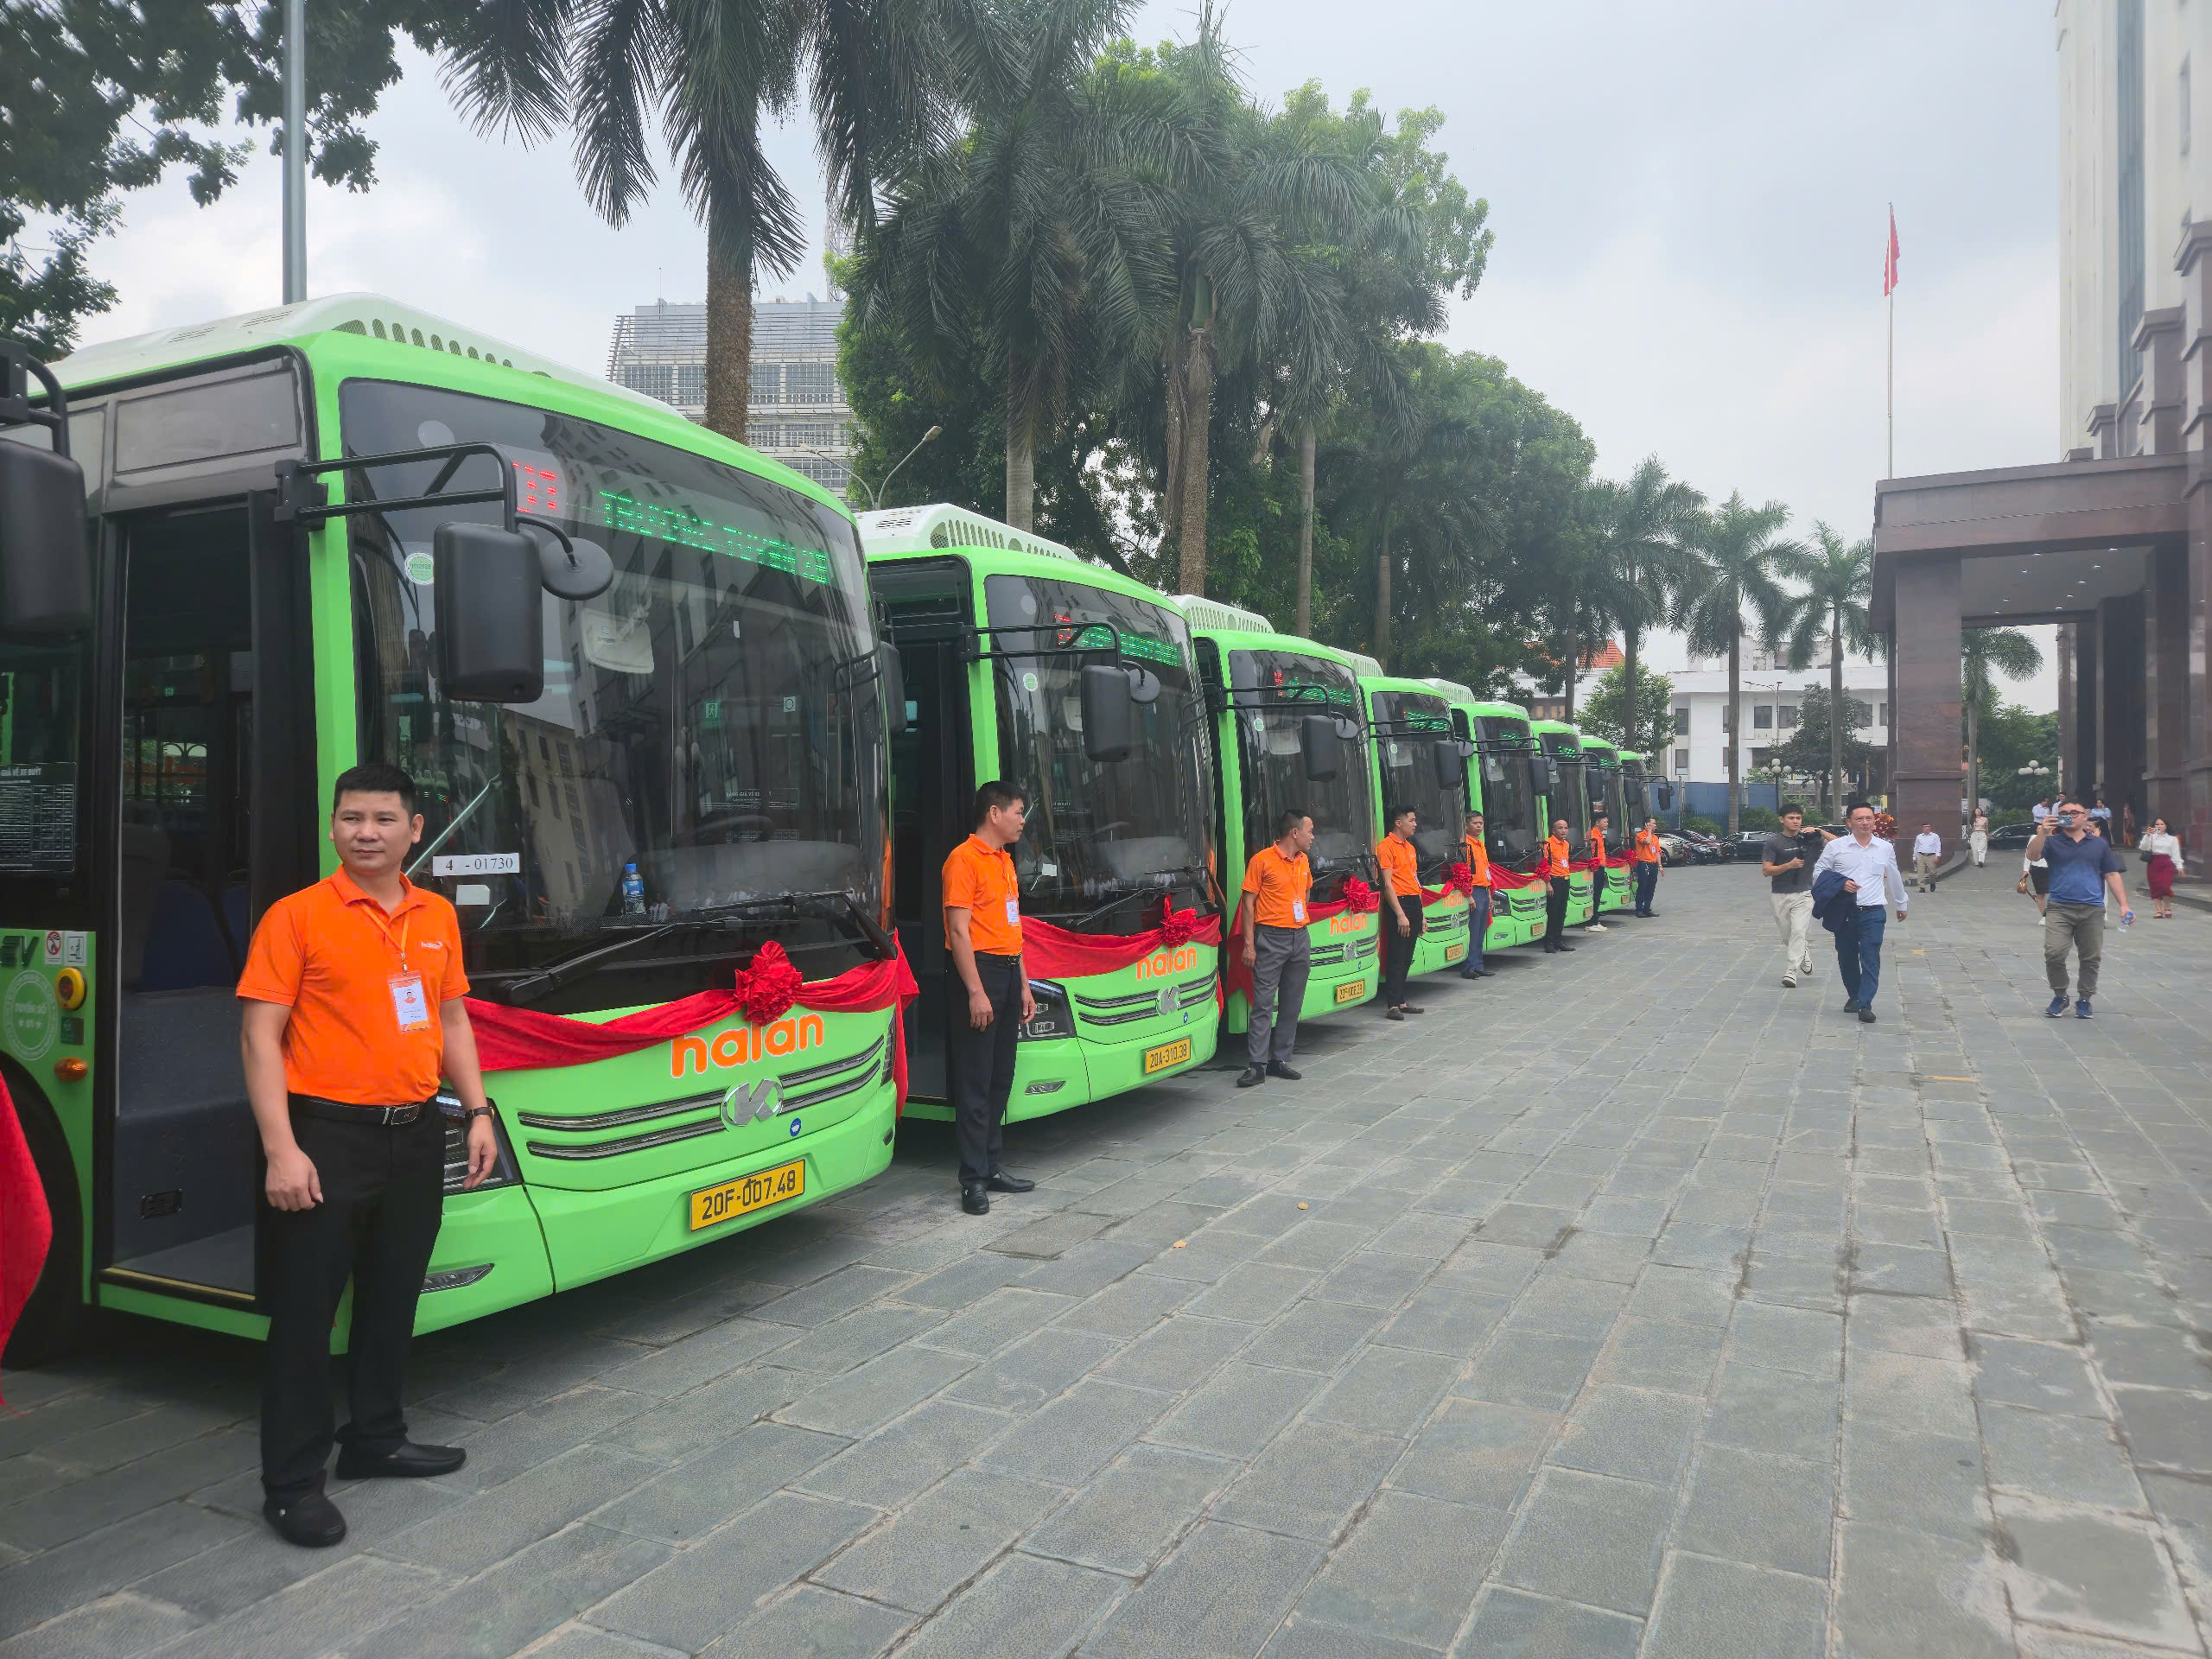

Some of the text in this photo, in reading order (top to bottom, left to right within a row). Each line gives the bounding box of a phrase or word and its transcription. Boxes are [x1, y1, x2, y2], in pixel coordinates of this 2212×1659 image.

[445, 859, 454, 871] 4
[474, 857, 513, 870] 01730
[1150, 1043, 1187, 1069] 20A-310.38
[702, 1169, 797, 1221] 20F-007.48
